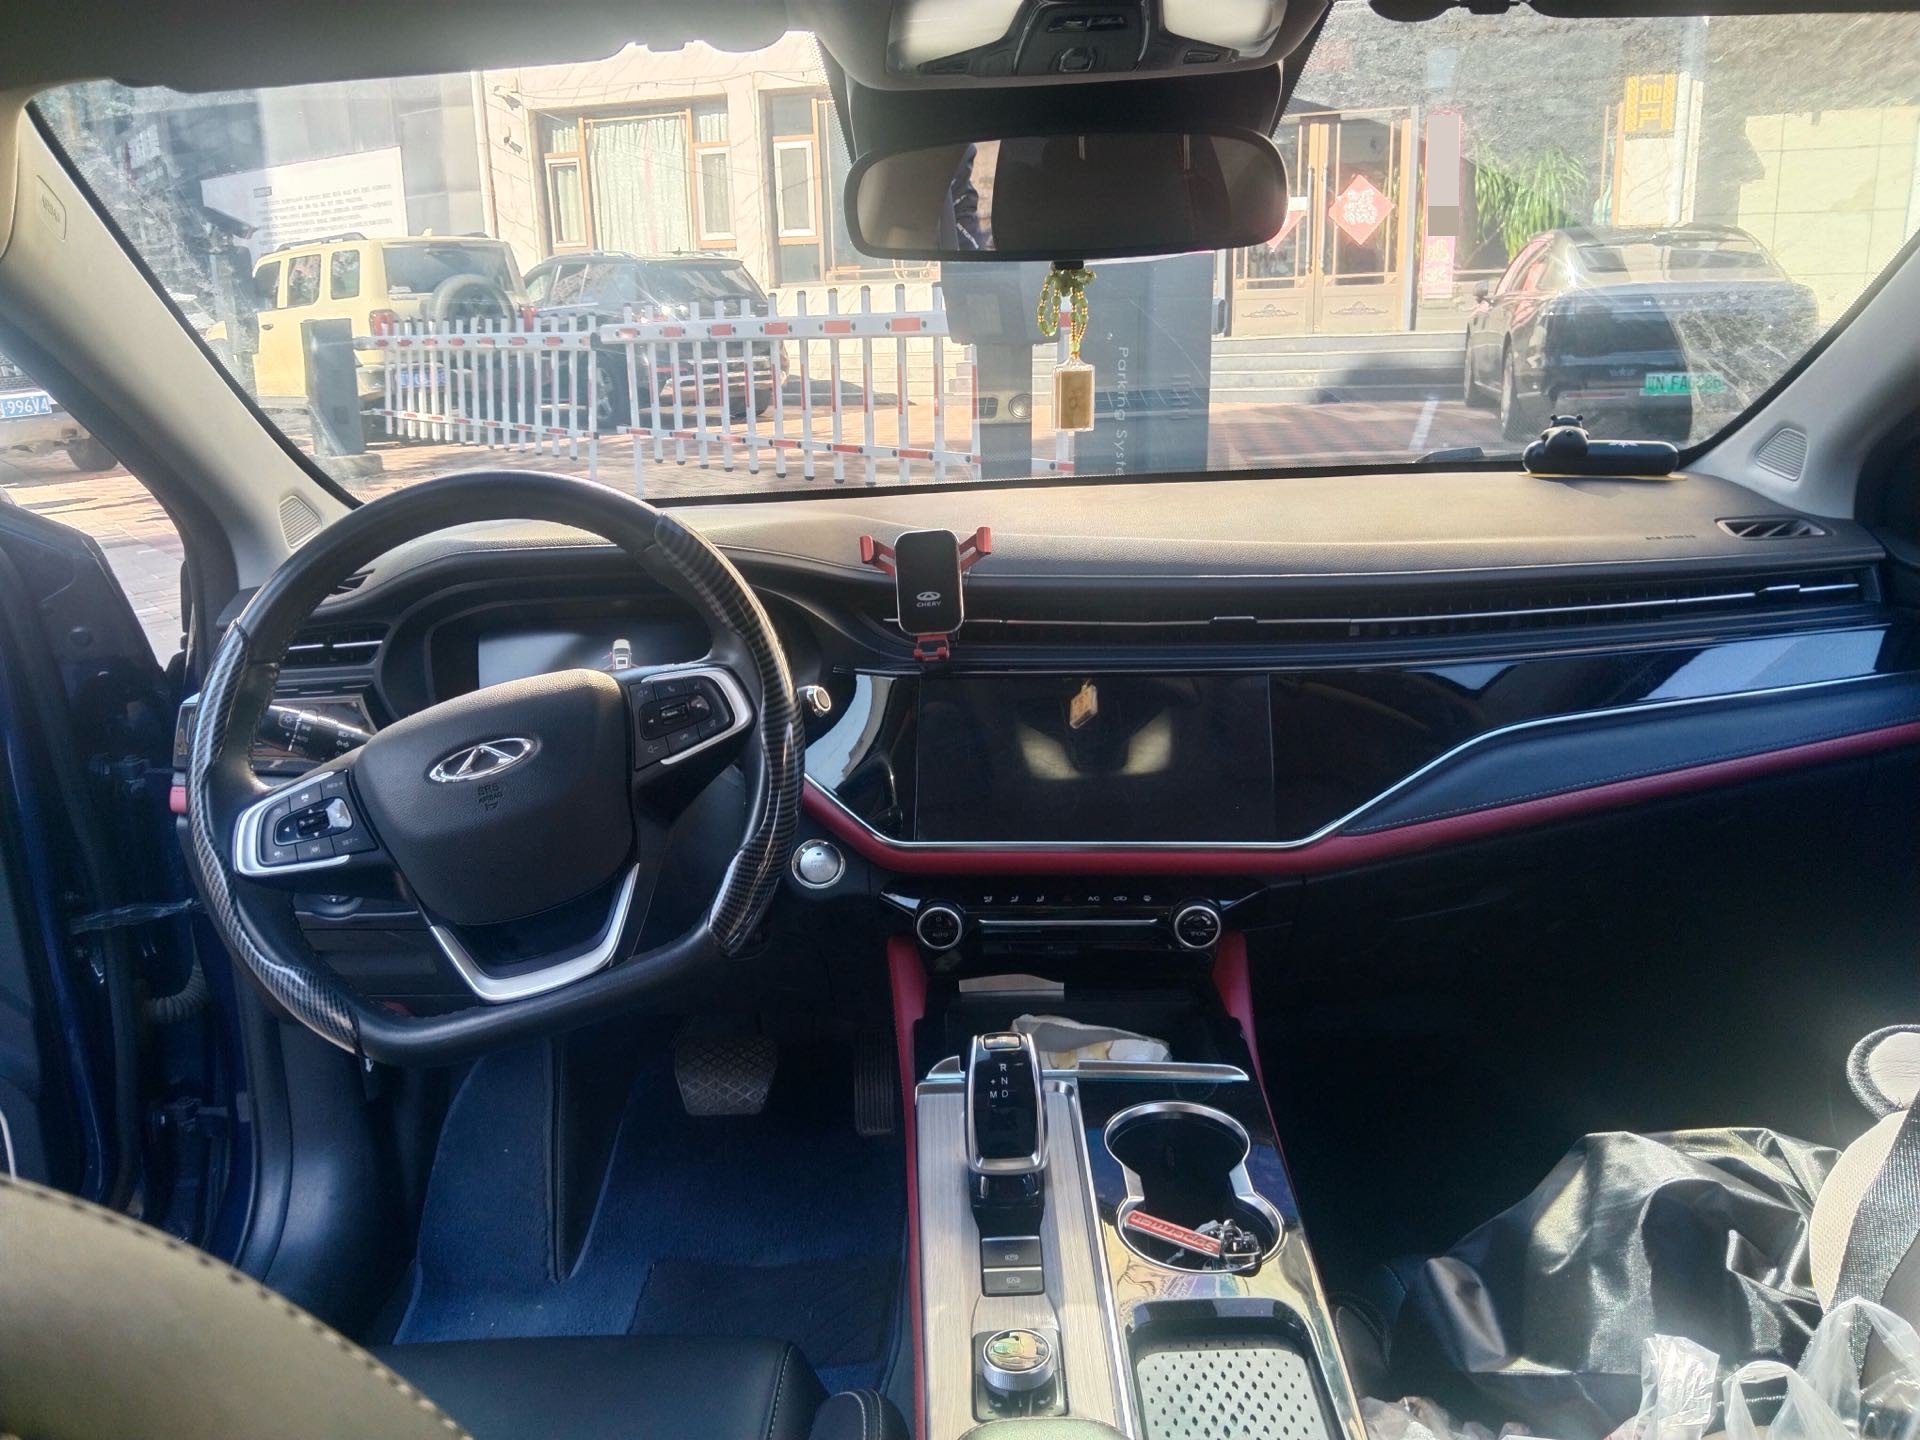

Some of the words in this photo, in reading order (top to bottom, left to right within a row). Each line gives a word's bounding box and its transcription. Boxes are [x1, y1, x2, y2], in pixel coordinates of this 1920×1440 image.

[1114, 346, 1129, 421] Parking
[1114, 429, 1128, 476] Syste
[999, 1063, 1008, 1072] R
[1000, 1076, 1009, 1085] N
[989, 1090, 998, 1099] M
[1001, 1089, 1009, 1098] D
